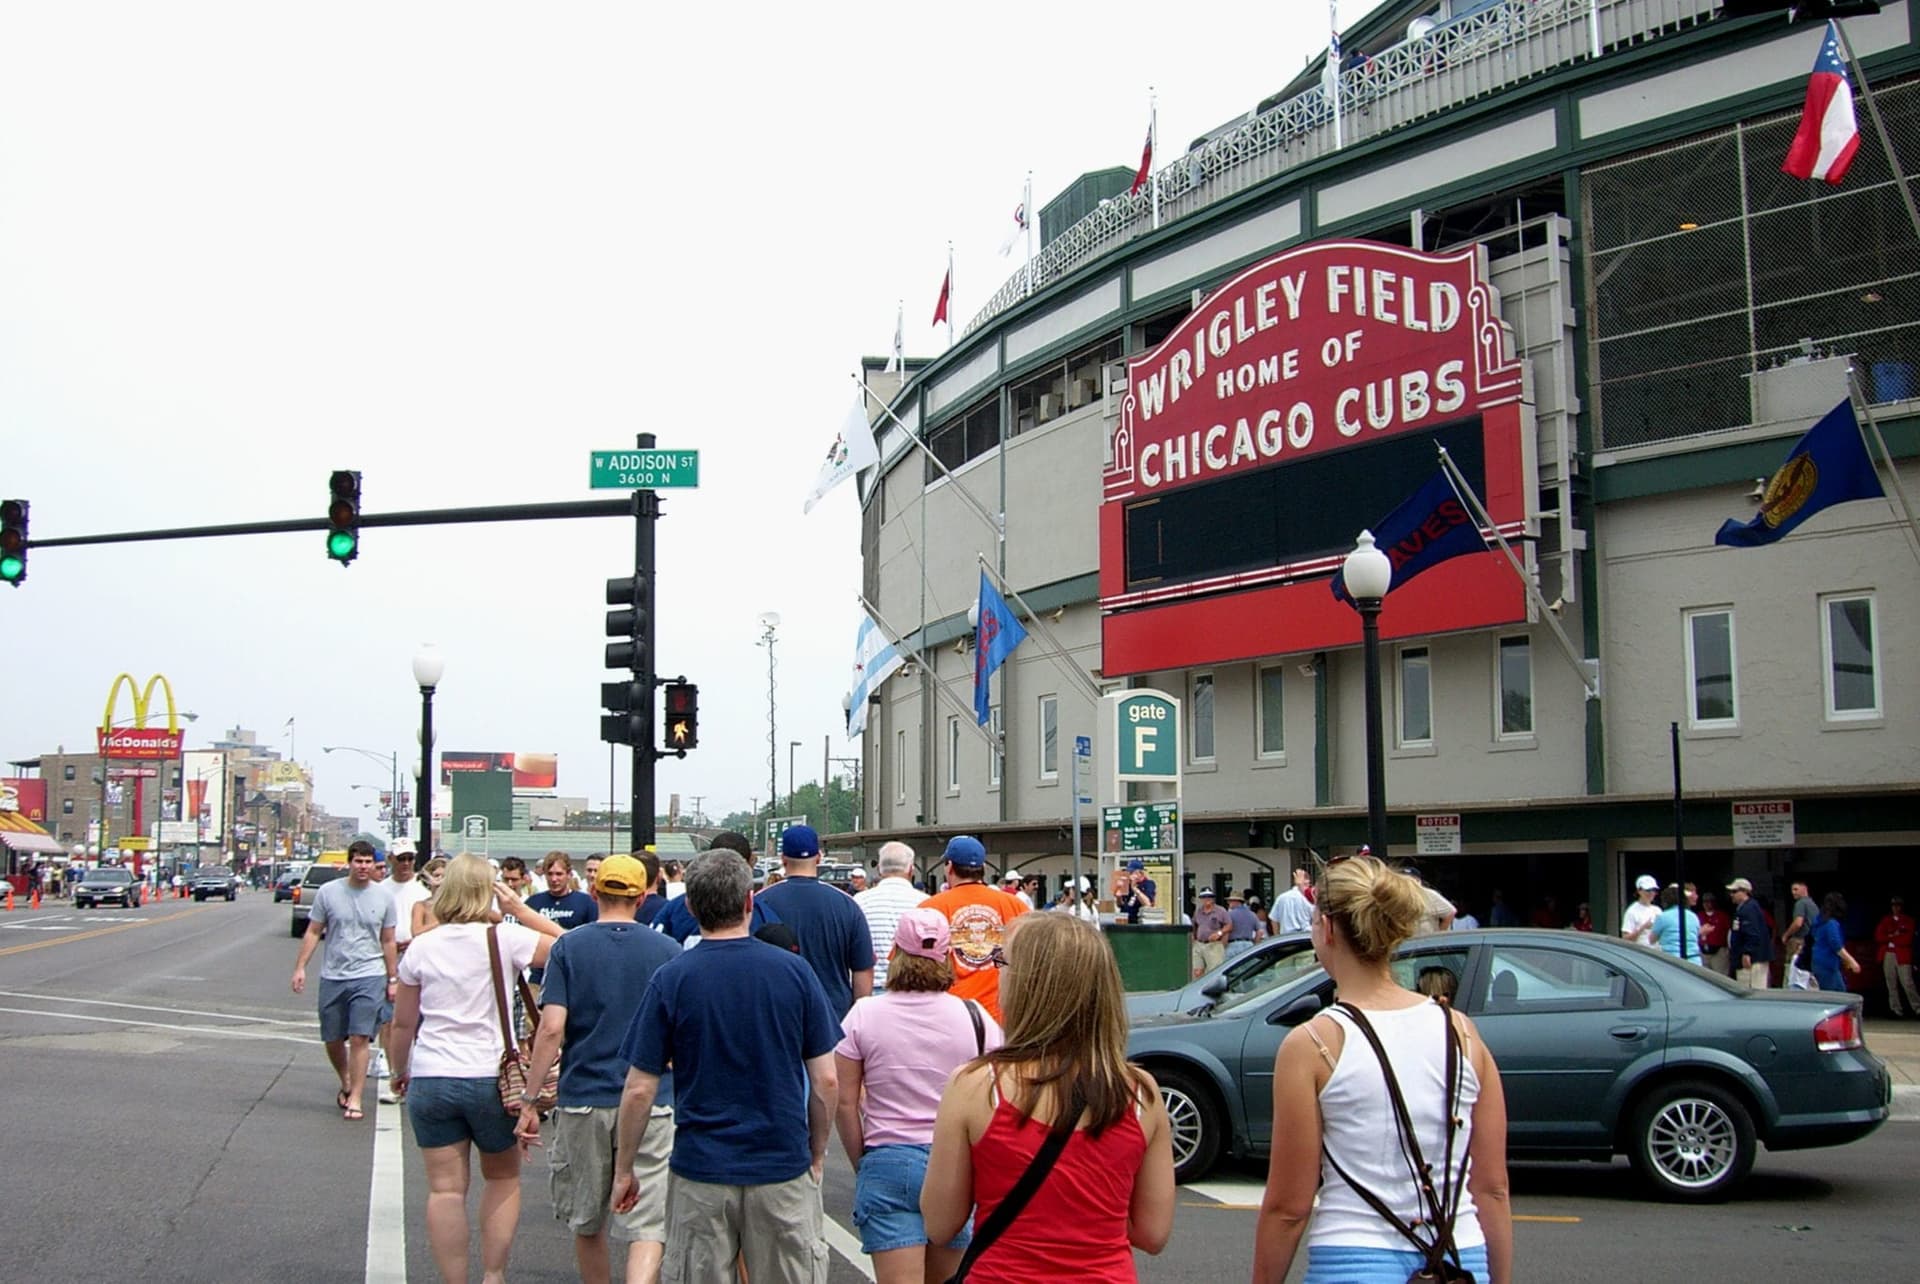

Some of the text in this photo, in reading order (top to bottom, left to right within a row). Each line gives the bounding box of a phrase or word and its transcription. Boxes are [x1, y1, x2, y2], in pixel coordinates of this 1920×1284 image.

[1138, 265, 1461, 421] WRIGLEY FIELD
[1216, 329, 1364, 400] HOME OF
[1139, 360, 1465, 488] CHICAGO CUBS
[595, 454, 694, 471] W ADDISON ST
[618, 472, 670, 484] 3600 N
[1387, 500, 1469, 572] AVES
[1128, 703, 1166, 723] gate
[1135, 726, 1158, 768] F
[1739, 804, 1785, 814] NOTICE
[1421, 817, 1454, 826] NOTICE
[1283, 823, 1295, 842] G
